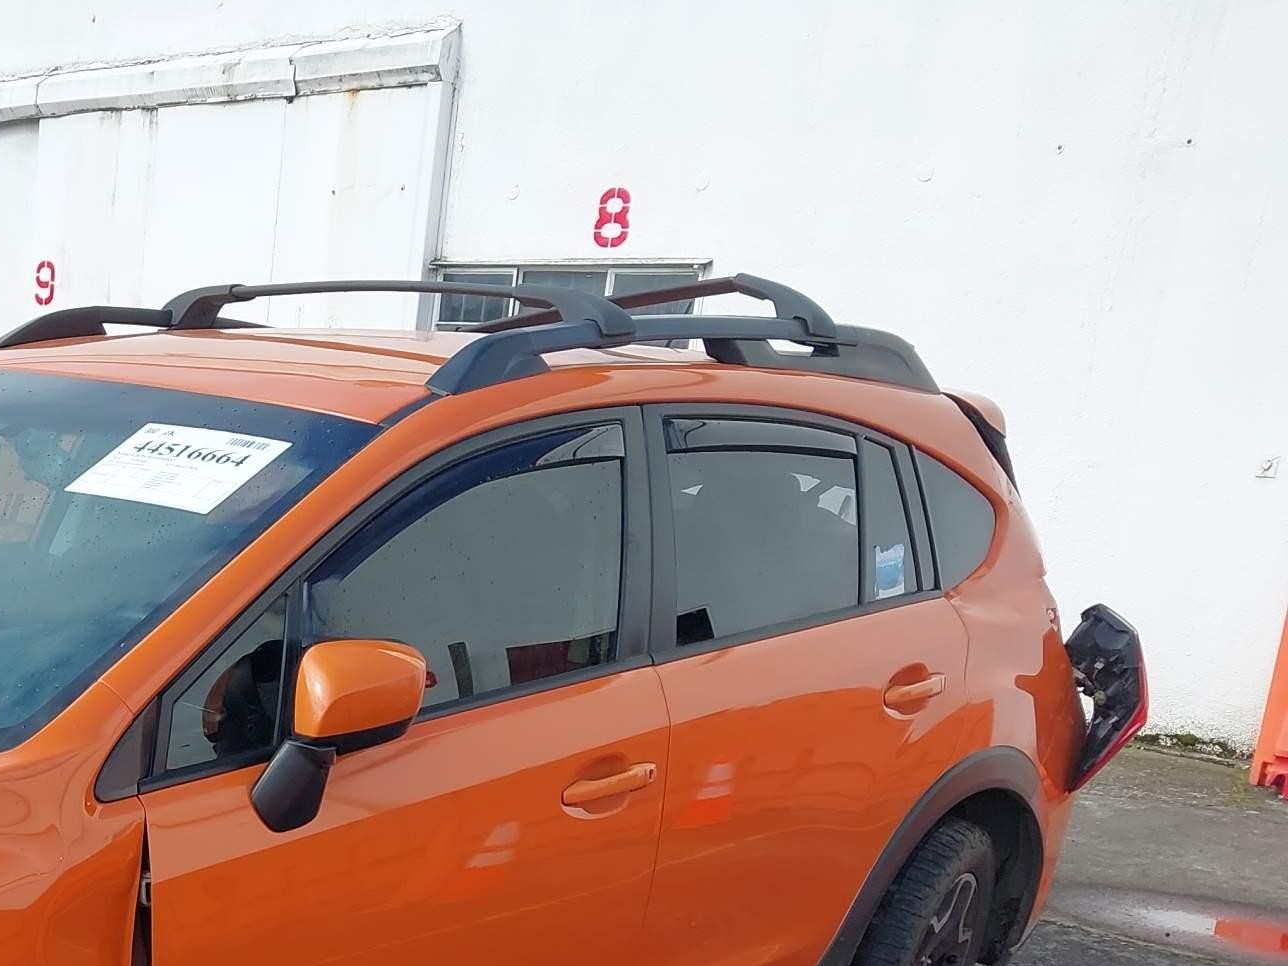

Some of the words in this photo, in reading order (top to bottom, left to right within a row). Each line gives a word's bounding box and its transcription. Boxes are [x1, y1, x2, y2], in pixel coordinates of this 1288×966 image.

[593, 187, 632, 249] 8
[34, 260, 56, 305] 9
[133, 440, 253, 468] 44516664
